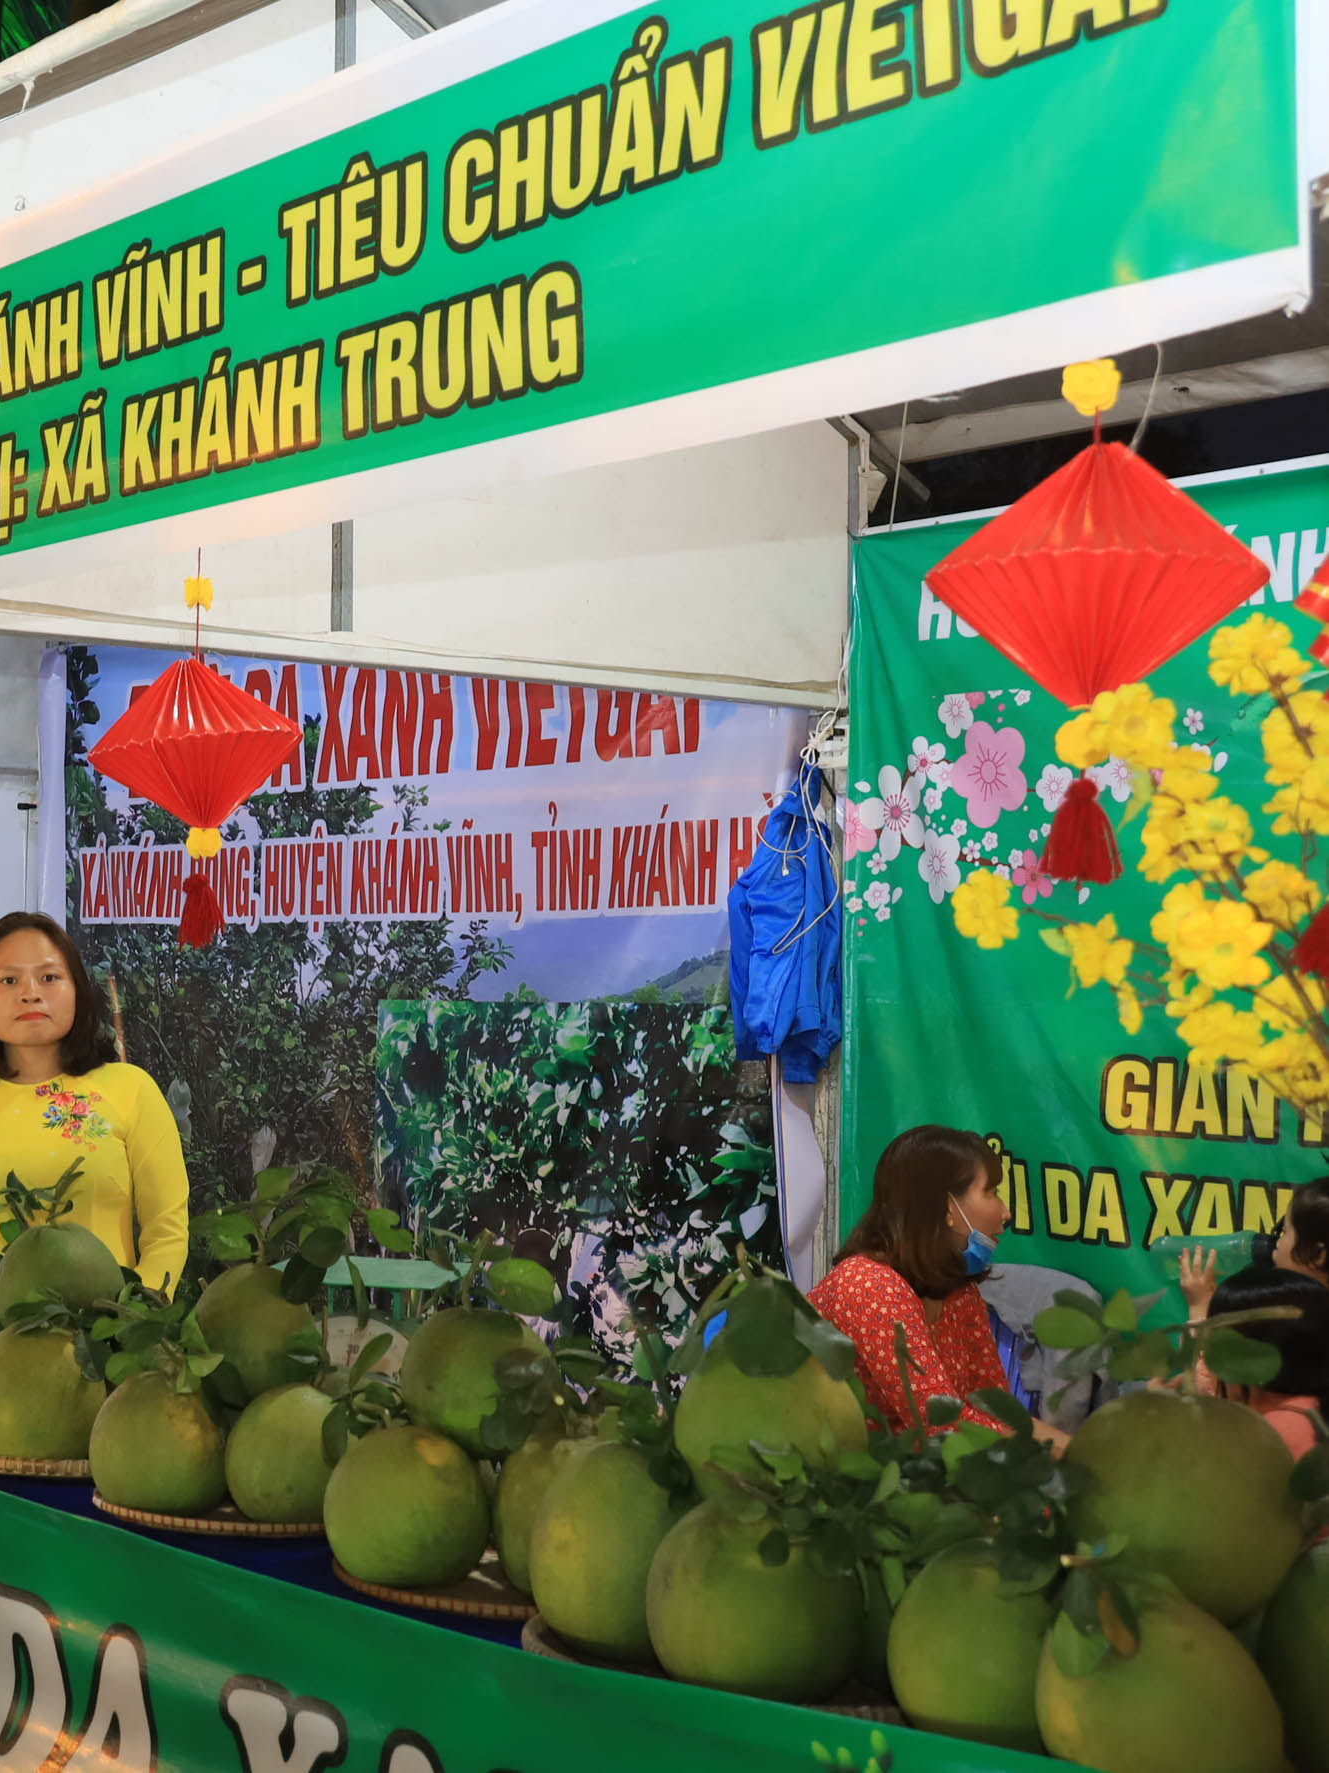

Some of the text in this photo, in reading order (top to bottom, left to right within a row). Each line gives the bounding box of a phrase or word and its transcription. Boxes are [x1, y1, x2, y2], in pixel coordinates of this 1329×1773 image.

[93, 228, 226, 369] VĨNH
[279, 151, 428, 308] TIÊU
[443, 15, 732, 254] CHUẨN
[38, 387, 110, 518] XÃ
[120, 339, 324, 496] KHÁNH
[335, 261, 584, 440] TRUNG
[317, 663, 454, 784] XANH
[110, 836, 184, 919] KHÁNH
[264, 826, 344, 934] HUYỆN
[350, 822, 439, 915] KHÁNH
[446, 819, 523, 923] VĨNH,
[531, 801, 603, 911] TỈNH
[607, 804, 719, 910] KHÁNH
[1041, 1161, 1132, 1250] DA
